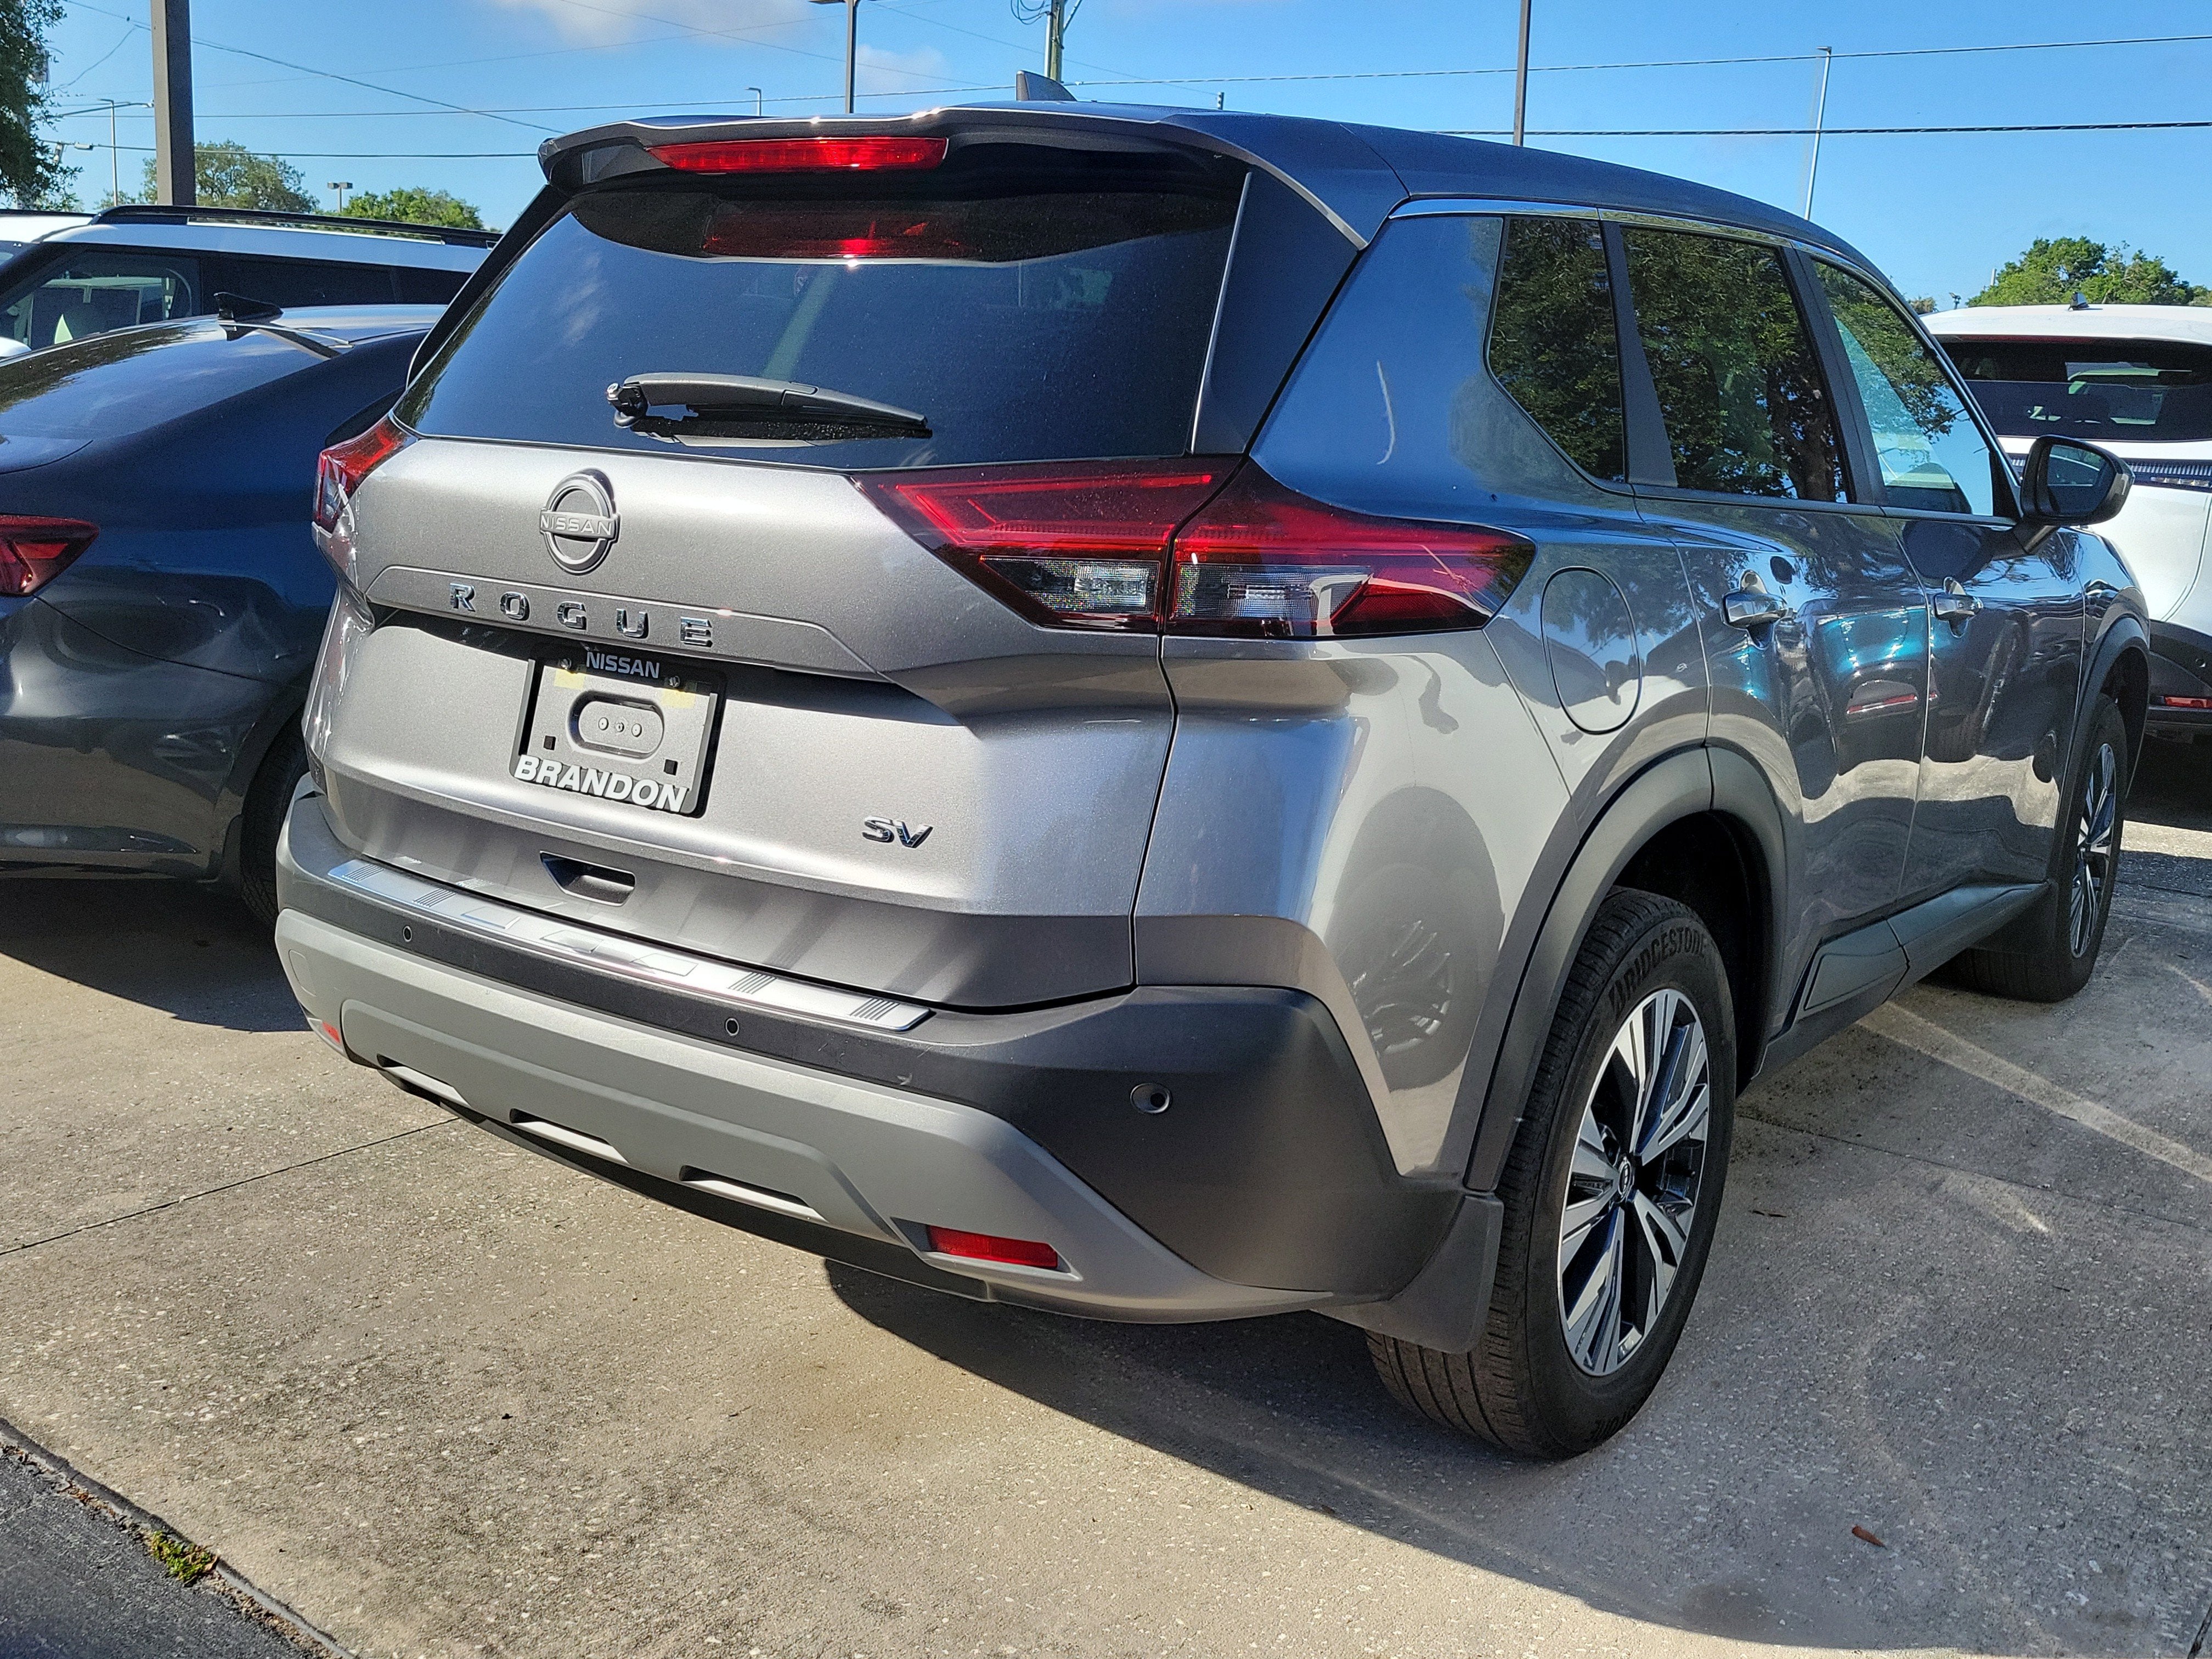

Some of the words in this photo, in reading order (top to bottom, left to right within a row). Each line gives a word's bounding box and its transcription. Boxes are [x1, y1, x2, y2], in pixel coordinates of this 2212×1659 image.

[540, 514, 612, 536] NISSAN
[449, 583, 713, 648] ROGUE
[586, 651, 660, 679] NISSAN
[514, 754, 689, 812] BRANDON
[861, 815, 934, 849] SV
